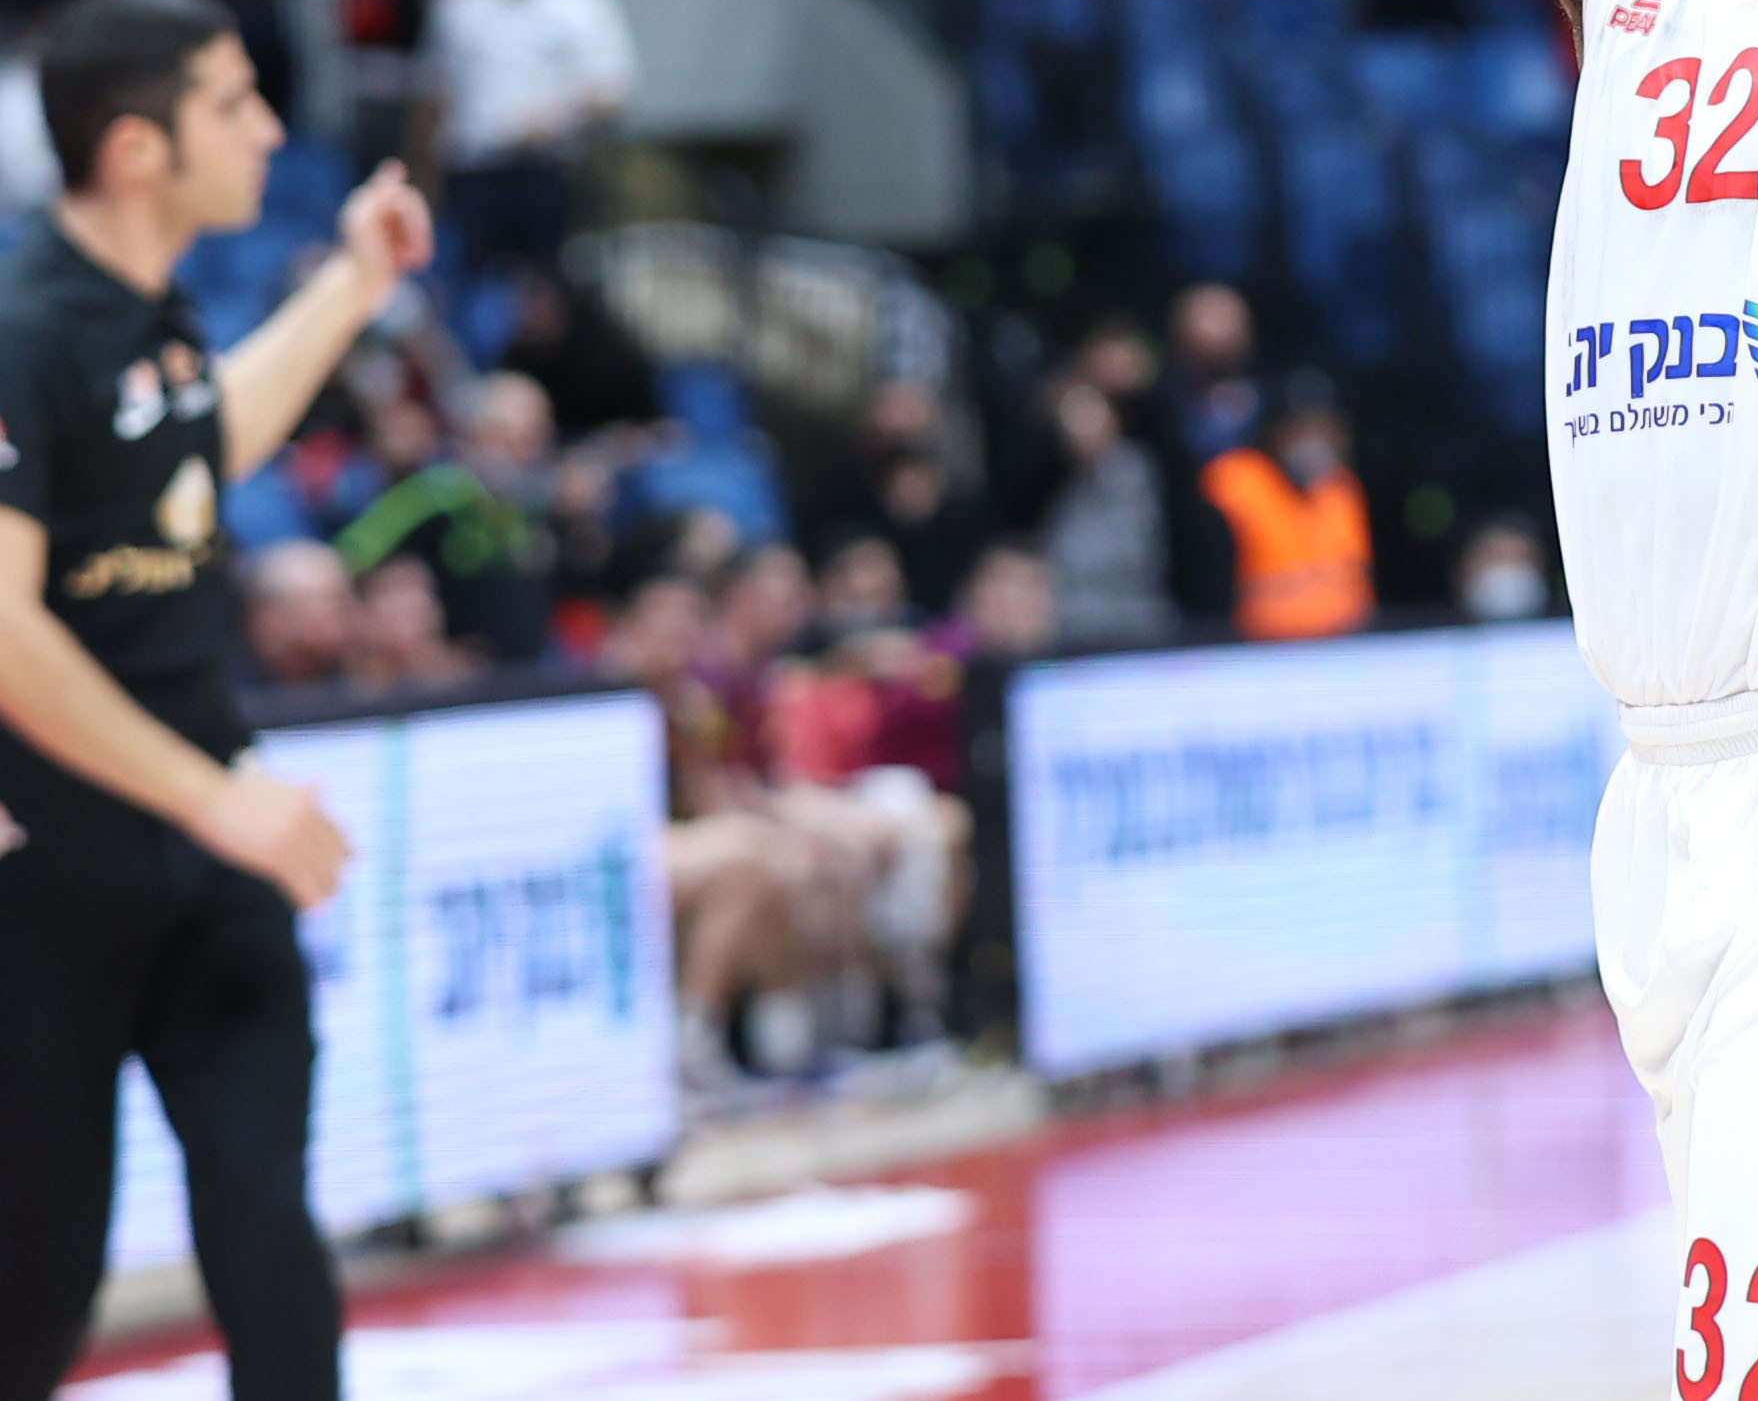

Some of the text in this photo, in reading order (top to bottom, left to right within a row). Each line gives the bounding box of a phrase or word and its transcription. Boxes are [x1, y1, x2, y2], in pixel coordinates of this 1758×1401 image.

[1566, 313, 1740, 399] בנק יה
[1610, 403, 1689, 432] משתלם
